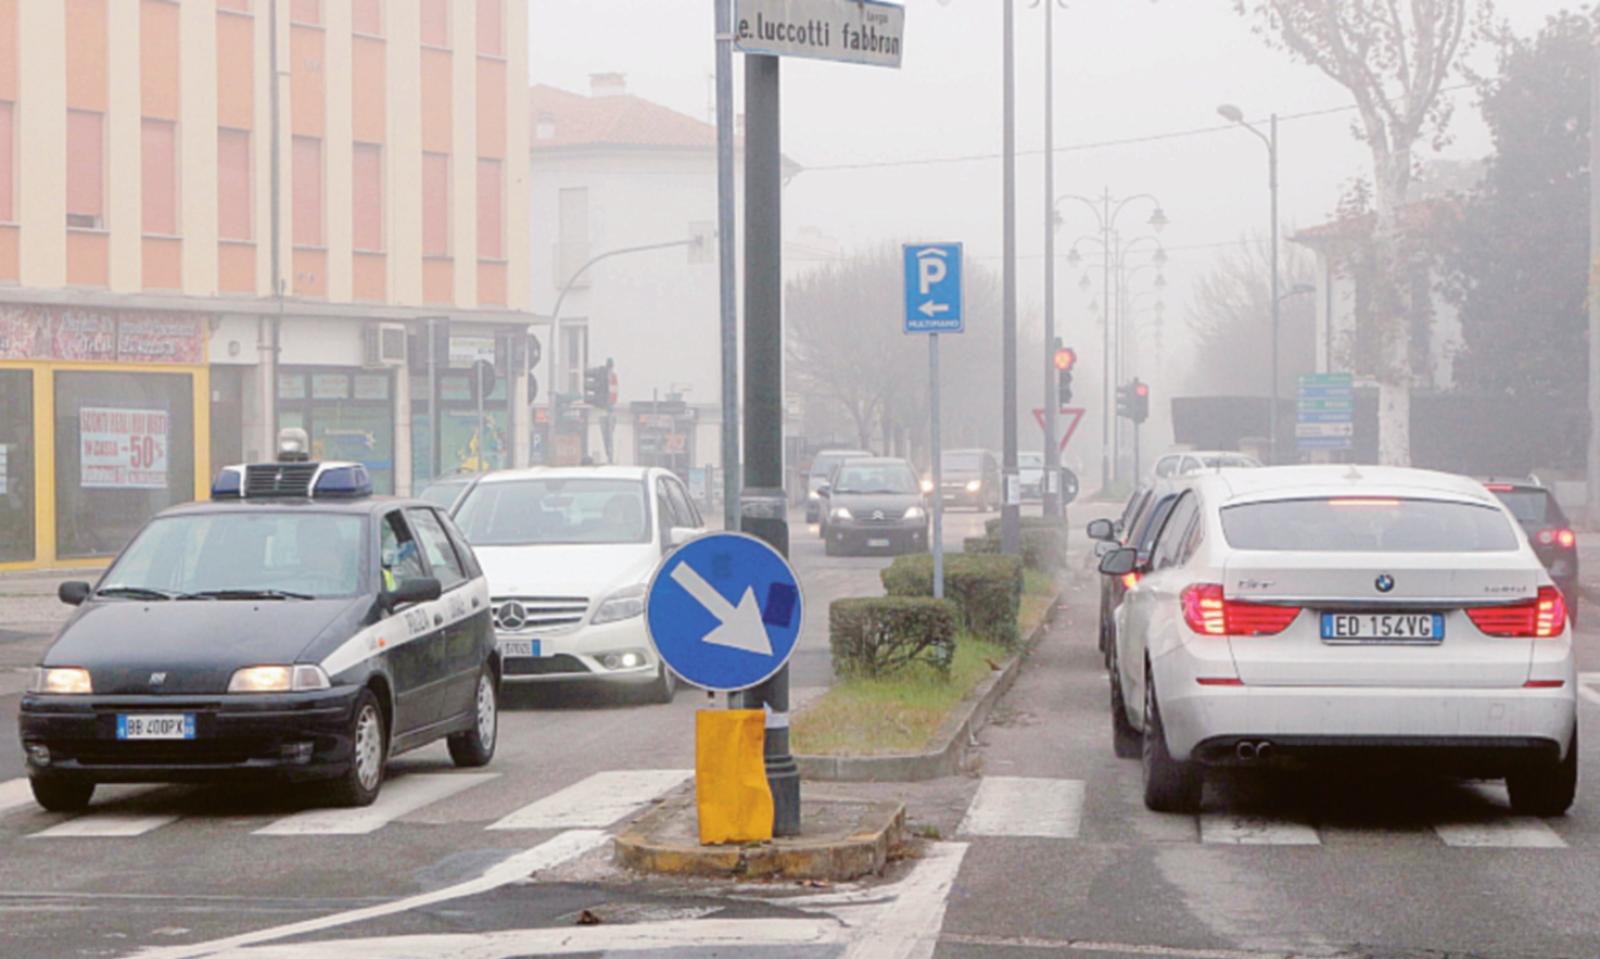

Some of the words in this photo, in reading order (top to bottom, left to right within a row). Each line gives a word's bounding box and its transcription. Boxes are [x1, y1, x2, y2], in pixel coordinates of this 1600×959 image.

[919, 257, 947, 295] P
[1335, 615, 1360, 636] ED
[1369, 615, 1431, 636] 154VG
